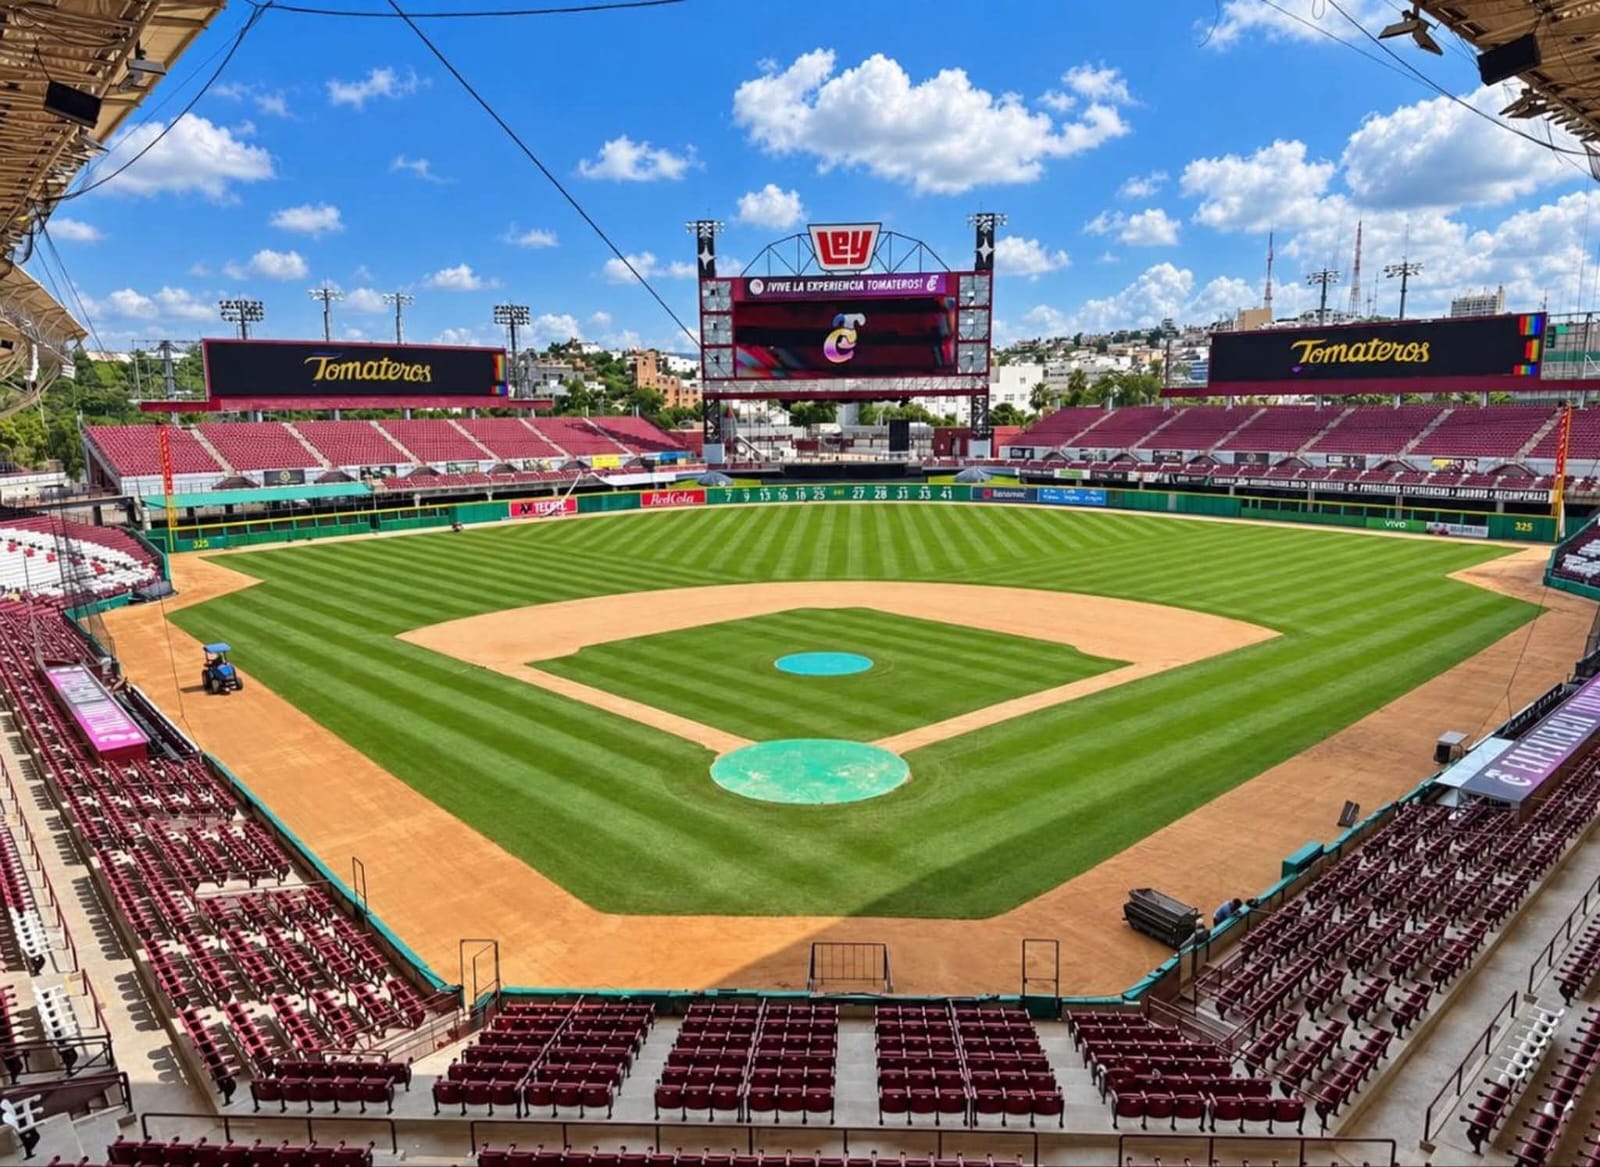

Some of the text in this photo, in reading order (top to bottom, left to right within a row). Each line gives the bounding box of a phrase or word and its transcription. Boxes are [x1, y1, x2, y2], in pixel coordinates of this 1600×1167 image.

[793, 282, 805, 292] LA
[806, 280, 864, 291] EXPERIENCIA
[867, 278, 923, 290] TOMATEROS!
[1290, 338, 1430, 363] Tomateros
[303, 356, 432, 382] Tomateros
[725, 492, 732, 502] 7
[743, 492, 750, 502] 9
[852, 490, 864, 499] 27
[874, 489, 887, 499] 28
[940, 490, 952, 499] 41
[1514, 521, 1533, 532] 325
